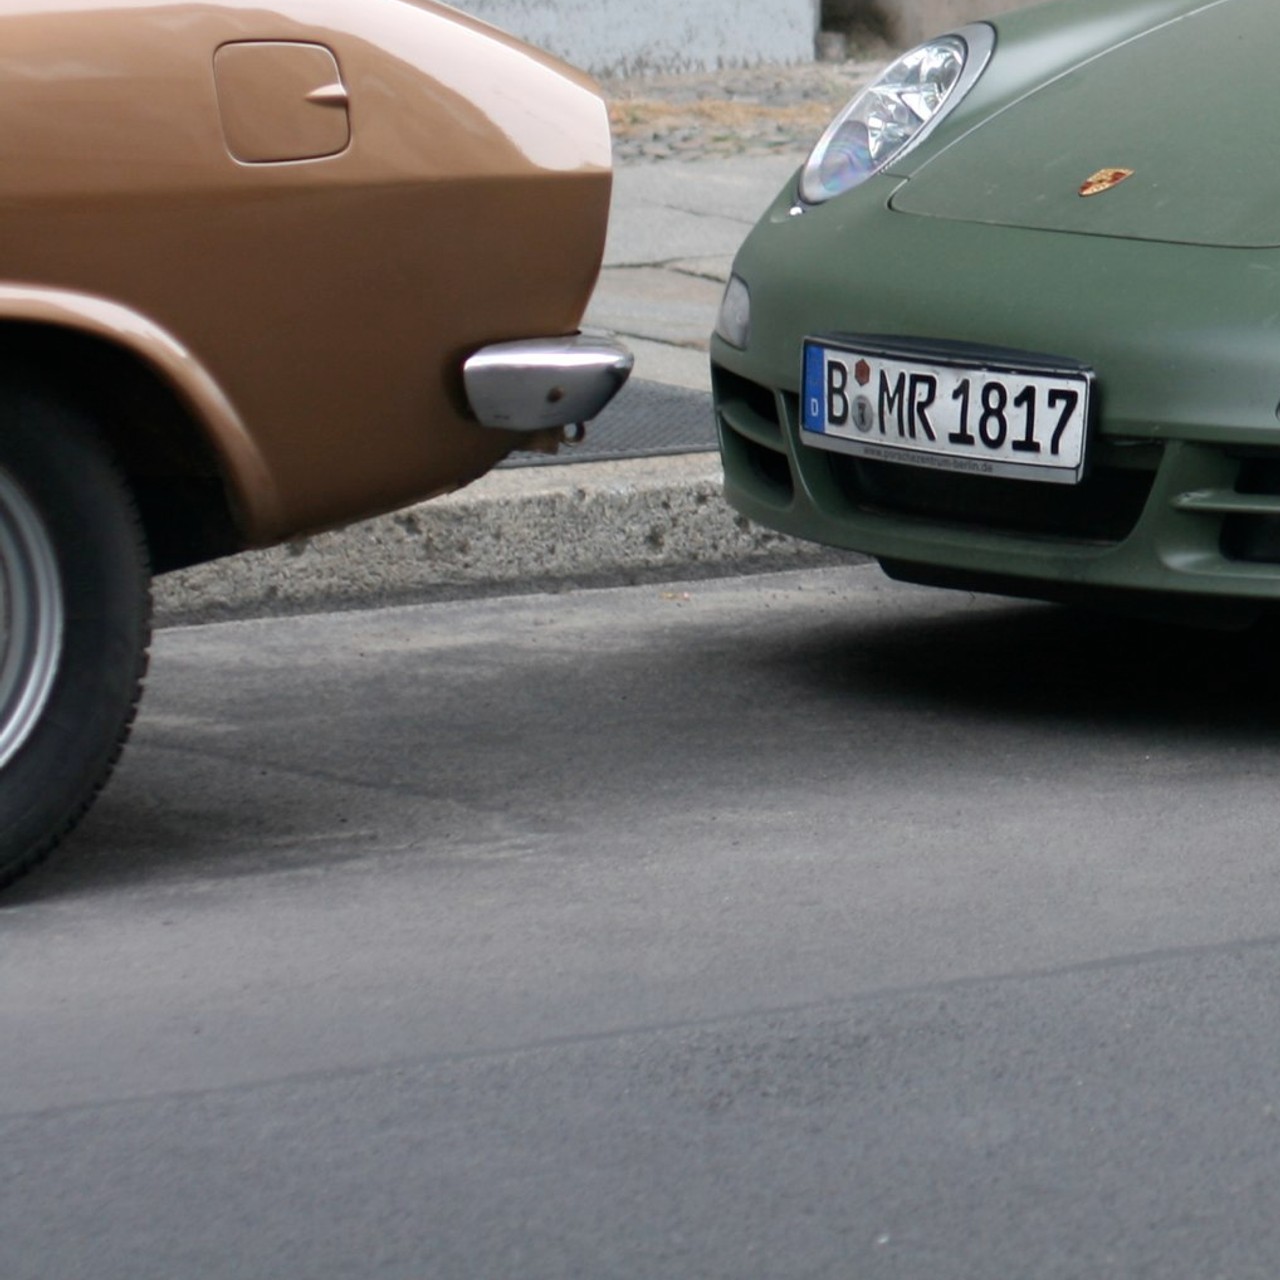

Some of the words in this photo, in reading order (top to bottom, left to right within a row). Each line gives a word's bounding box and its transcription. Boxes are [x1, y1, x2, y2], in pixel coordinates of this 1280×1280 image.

[810, 398, 819, 417] D
[827, 360, 849, 426] B
[878, 369, 937, 441] MR
[949, 378, 1079, 456] 1817
